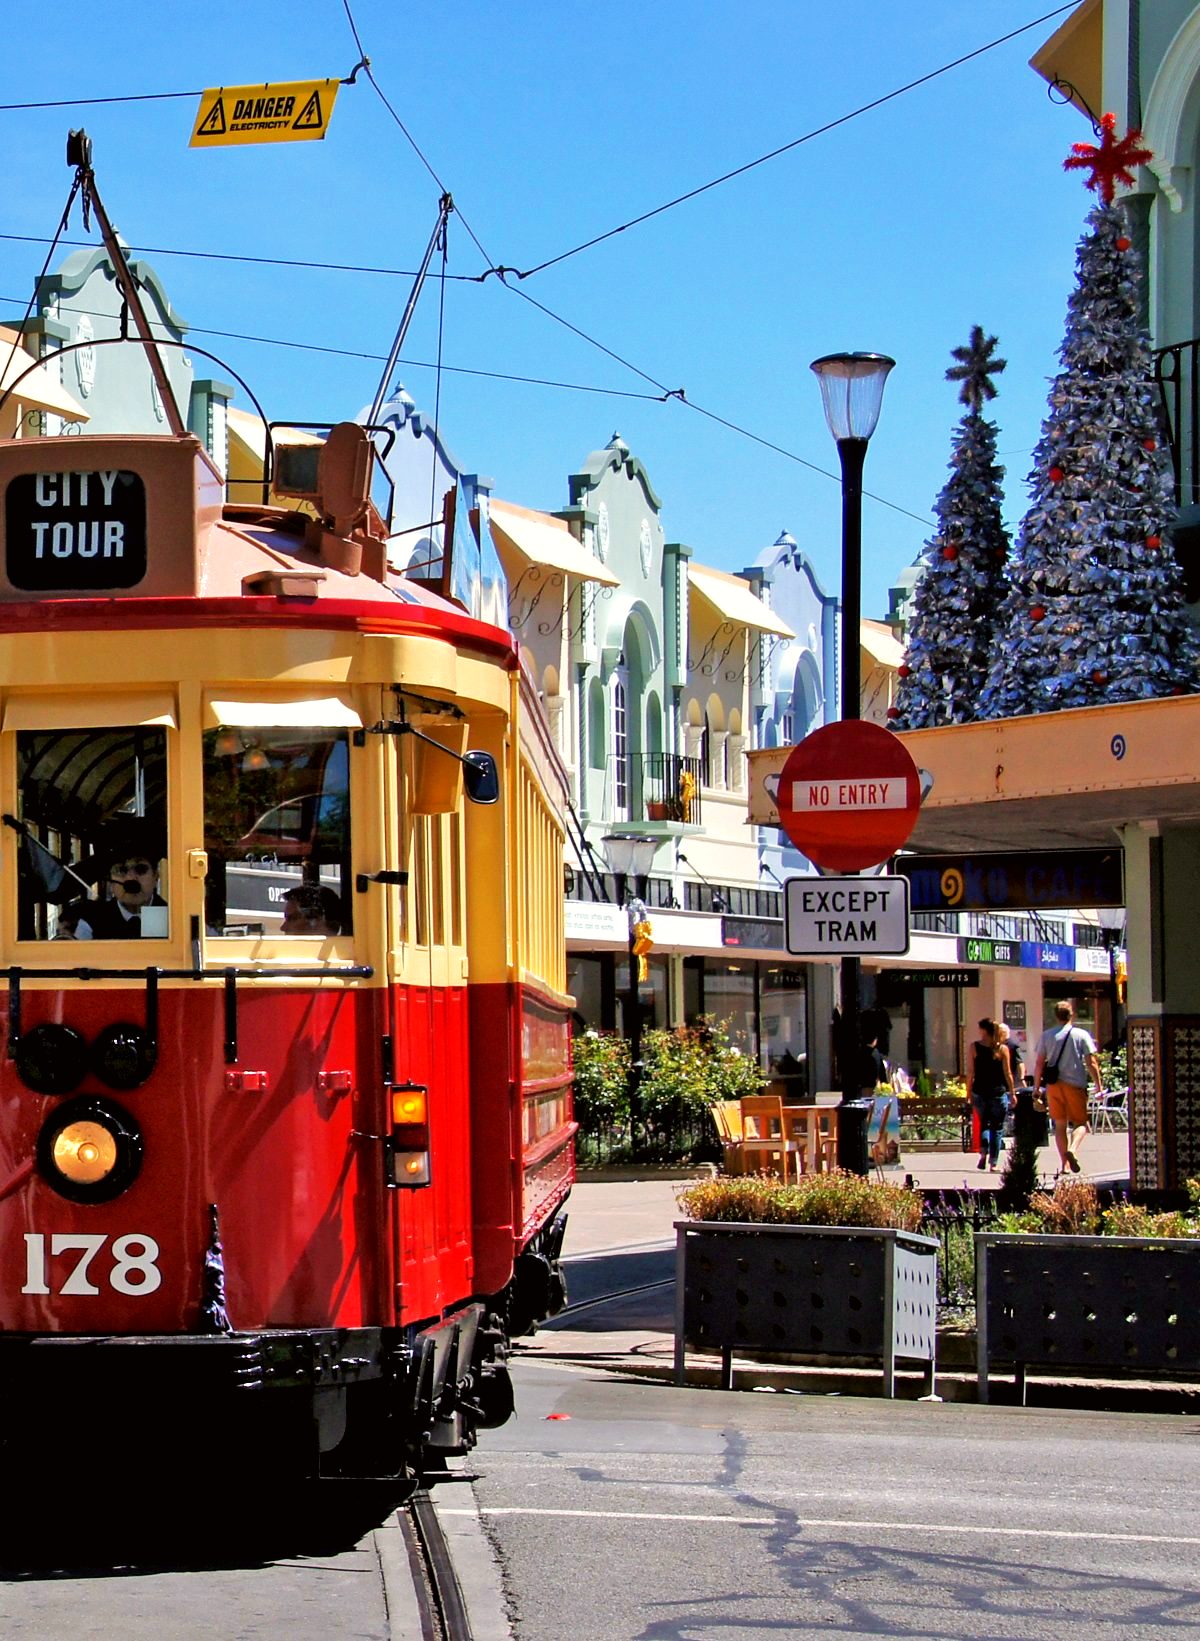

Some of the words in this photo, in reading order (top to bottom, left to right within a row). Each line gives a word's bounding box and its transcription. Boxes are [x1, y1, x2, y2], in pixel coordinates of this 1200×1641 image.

[233, 96, 296, 120] DANGER
[230, 120, 290, 131] ELECTRICITY
[35, 471, 119, 507] CITY
[31, 521, 124, 558] TOUR
[809, 785, 830, 806] NO
[839, 783, 889, 805] ENTRY
[802, 891, 890, 913] EXCEPT
[814, 920, 877, 941] TRAM
[994, 945, 1011, 960] GIFTS
[938, 973, 969, 983] GIFTS
[21, 1233, 162, 1296] 178
